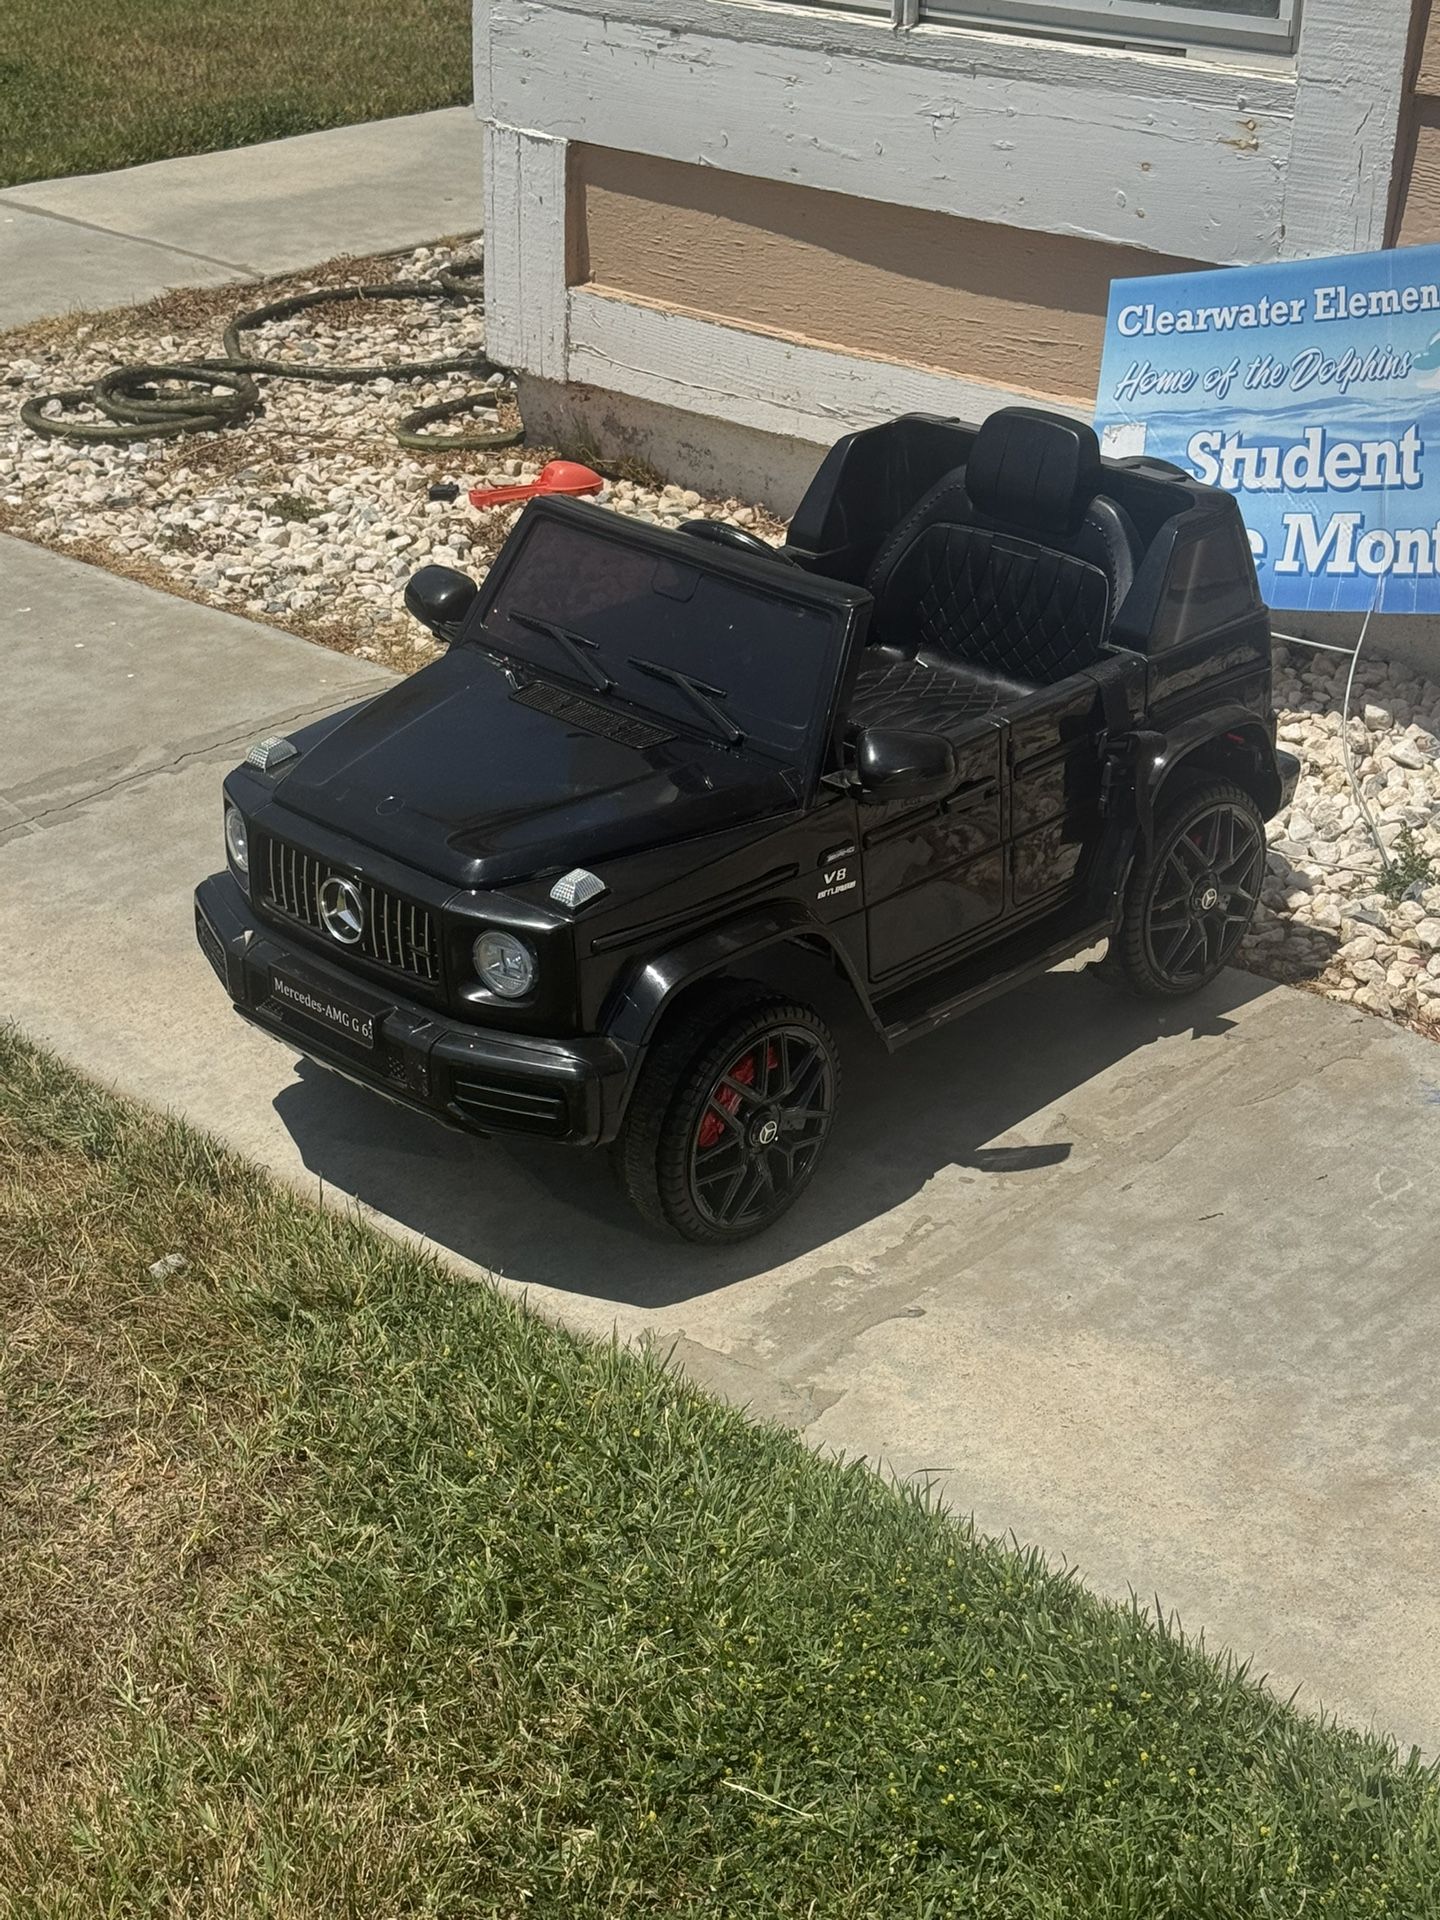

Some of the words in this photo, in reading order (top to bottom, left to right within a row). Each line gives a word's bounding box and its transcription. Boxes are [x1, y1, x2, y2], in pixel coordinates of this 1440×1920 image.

[1117, 295, 1305, 336] Clearwater
[1114, 361, 1198, 400] Home
[1203, 357, 1240, 399] of
[1243, 354, 1289, 388] the
[1290, 345, 1412, 393] Dolphins
[1186, 423, 1424, 492] Student
[824, 867, 847, 885] V8
[274, 977, 349, 1027] Mercedes-AMG
[351, 1018, 360, 1032] G
